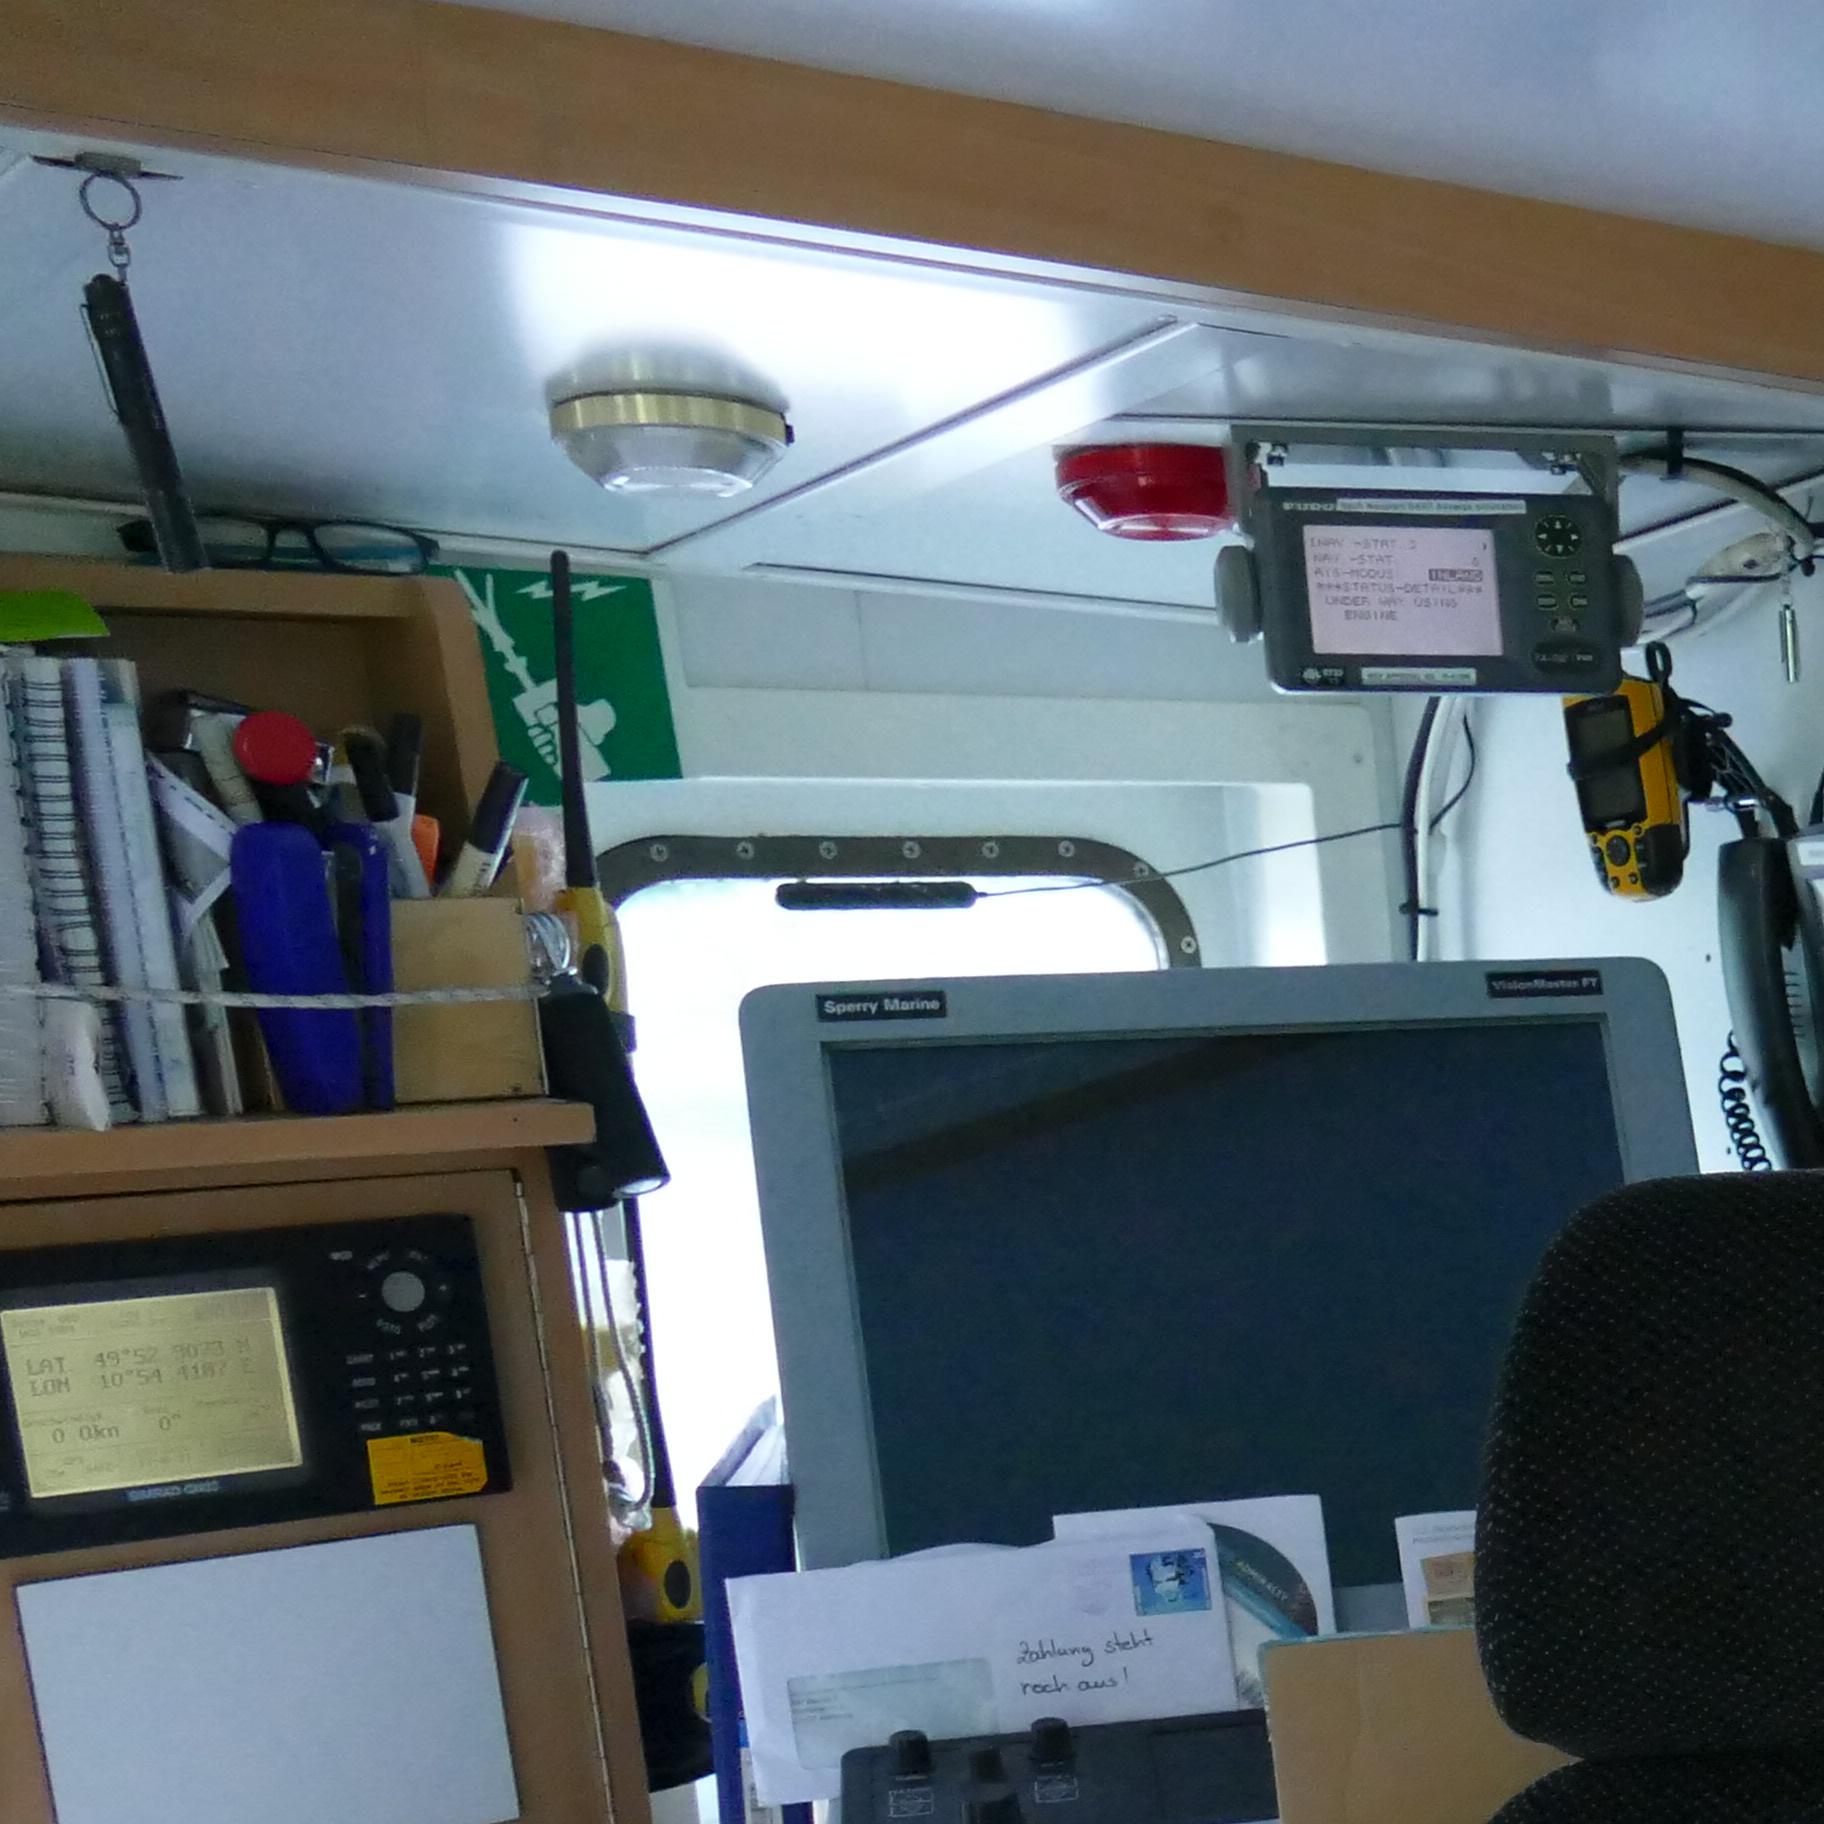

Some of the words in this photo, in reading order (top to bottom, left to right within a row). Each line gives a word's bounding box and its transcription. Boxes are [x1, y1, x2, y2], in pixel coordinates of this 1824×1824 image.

[1325, 597, 1371, 607] UNDER
[1414, 598, 1458, 609] USING
[1344, 609, 1398, 621] ENGINE
[823, 998, 878, 1017] Sperry
[883, 995, 941, 1013] Marine
[1016, 1638, 1095, 1668] Zahlung
[1103, 1627, 1153, 1654] steht
